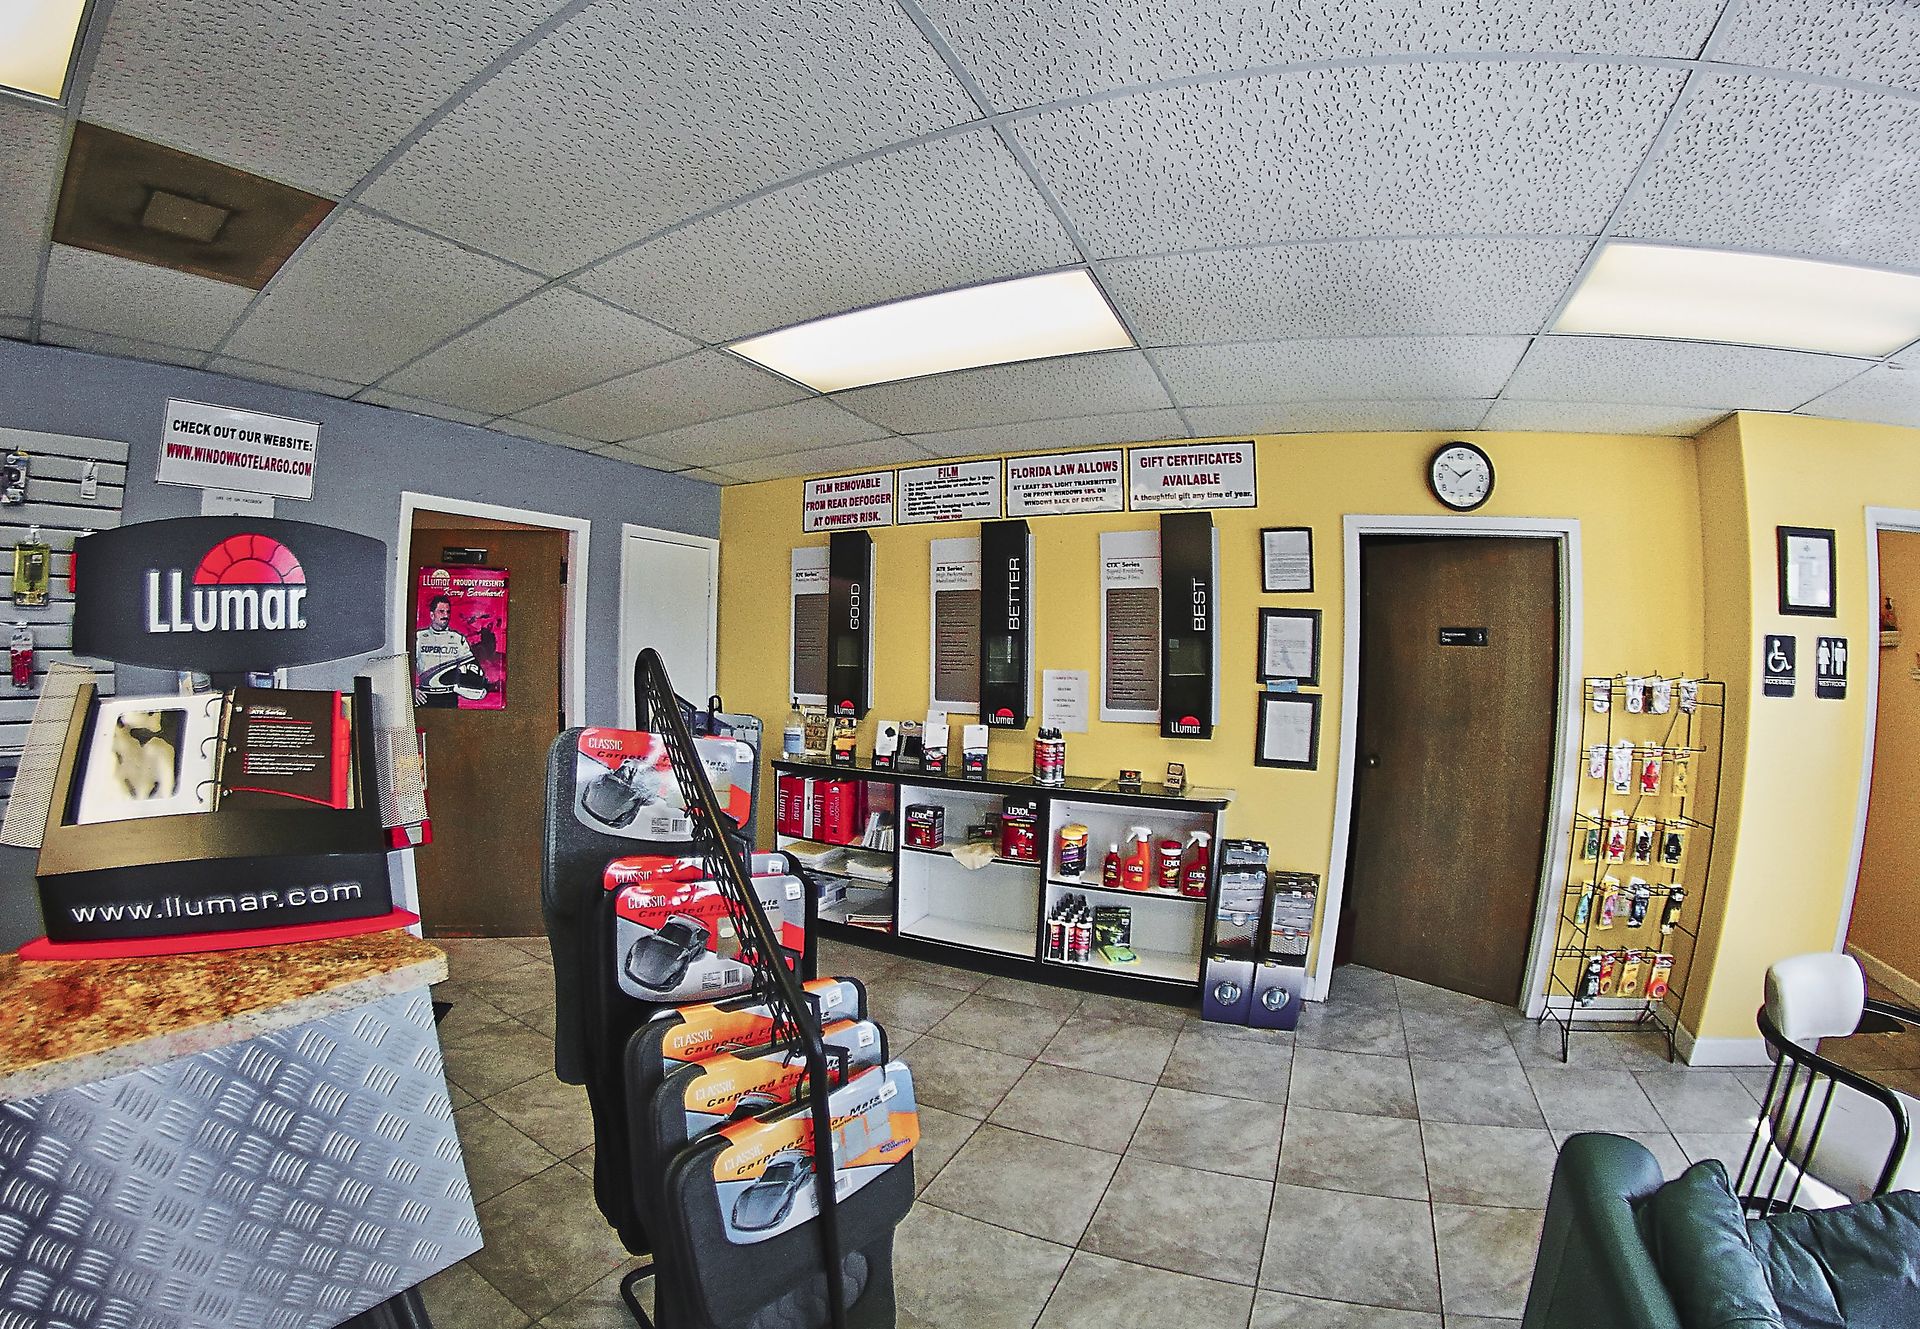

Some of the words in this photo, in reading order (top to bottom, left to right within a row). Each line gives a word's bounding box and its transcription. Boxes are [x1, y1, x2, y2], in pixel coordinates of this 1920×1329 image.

[173, 419, 211, 436] CHECK
[213, 426, 237, 439] OUT
[239, 429, 261, 444] OUR
[263, 433, 313, 451] WEBSITE:
[166, 442, 312, 477] WWW.WINDOWKOTELARGO.COM
[1140, 456, 1164, 468] GIFT
[1166, 452, 1242, 467] CERTIFICATES
[938, 466, 958, 477] FILM
[1011, 465, 1052, 479] FLORIDA
[1054, 463, 1075, 476] LAW
[1077, 460, 1118, 474] ALLOWS
[816, 483, 832, 494] FILM
[834, 478, 881, 492] REMOVABLE
[1074, 478, 1117, 487] TRANSMITTED
[1162, 473, 1221, 486] AVAILABLE
[806, 500, 826, 511] FROM
[827, 498, 848, 510] REAR
[849, 493, 891, 507] DEFOGGER
[1140, 493, 1177, 501] thoughtful
[1178, 492, 1191, 501] gift
[1224, 490, 1233, 498] of
[1234, 490, 1252, 499] year.
[814, 517, 824, 527] AT
[825, 513, 859, 526] OWNER'S
[860, 511, 881, 522] RISK.
[453, 579, 477, 587] PROUDLY
[479, 579, 505, 587] PRESENTS
[443, 587, 464, 598] Kerry
[467, 587, 505, 597] Earnhardt
[1008, 557, 1020, 630] BETTER
[850, 583, 860, 630] GOOD
[1193, 577, 1206, 631] BEST
[420, 645, 458, 654] SUPERCUTS
[834, 704, 855, 715] LLumar
[989, 713, 1015, 725] LLumar
[1171, 721, 1200, 733] LLumar
[588, 737, 623, 751] CLASSIC
[1007, 806, 1030, 816] LEXOL
[615, 870, 652, 883] CLASSIC
[1128, 865, 1144, 873] LEXOL
[71, 883, 363, 923] www.llumar.com
[628, 895, 666, 910] CLASSIC
[638, 906, 705, 918] Carpeted
[673, 1028, 714, 1049] CLASSIC
[684, 1031, 754, 1056] Carpeted
[695, 1079, 736, 1101] CLASSIC
[706, 1079, 776, 1108] Carpeted
[736, 1135, 804, 1175] Carpeted
[850, 1095, 881, 1116] Mats
